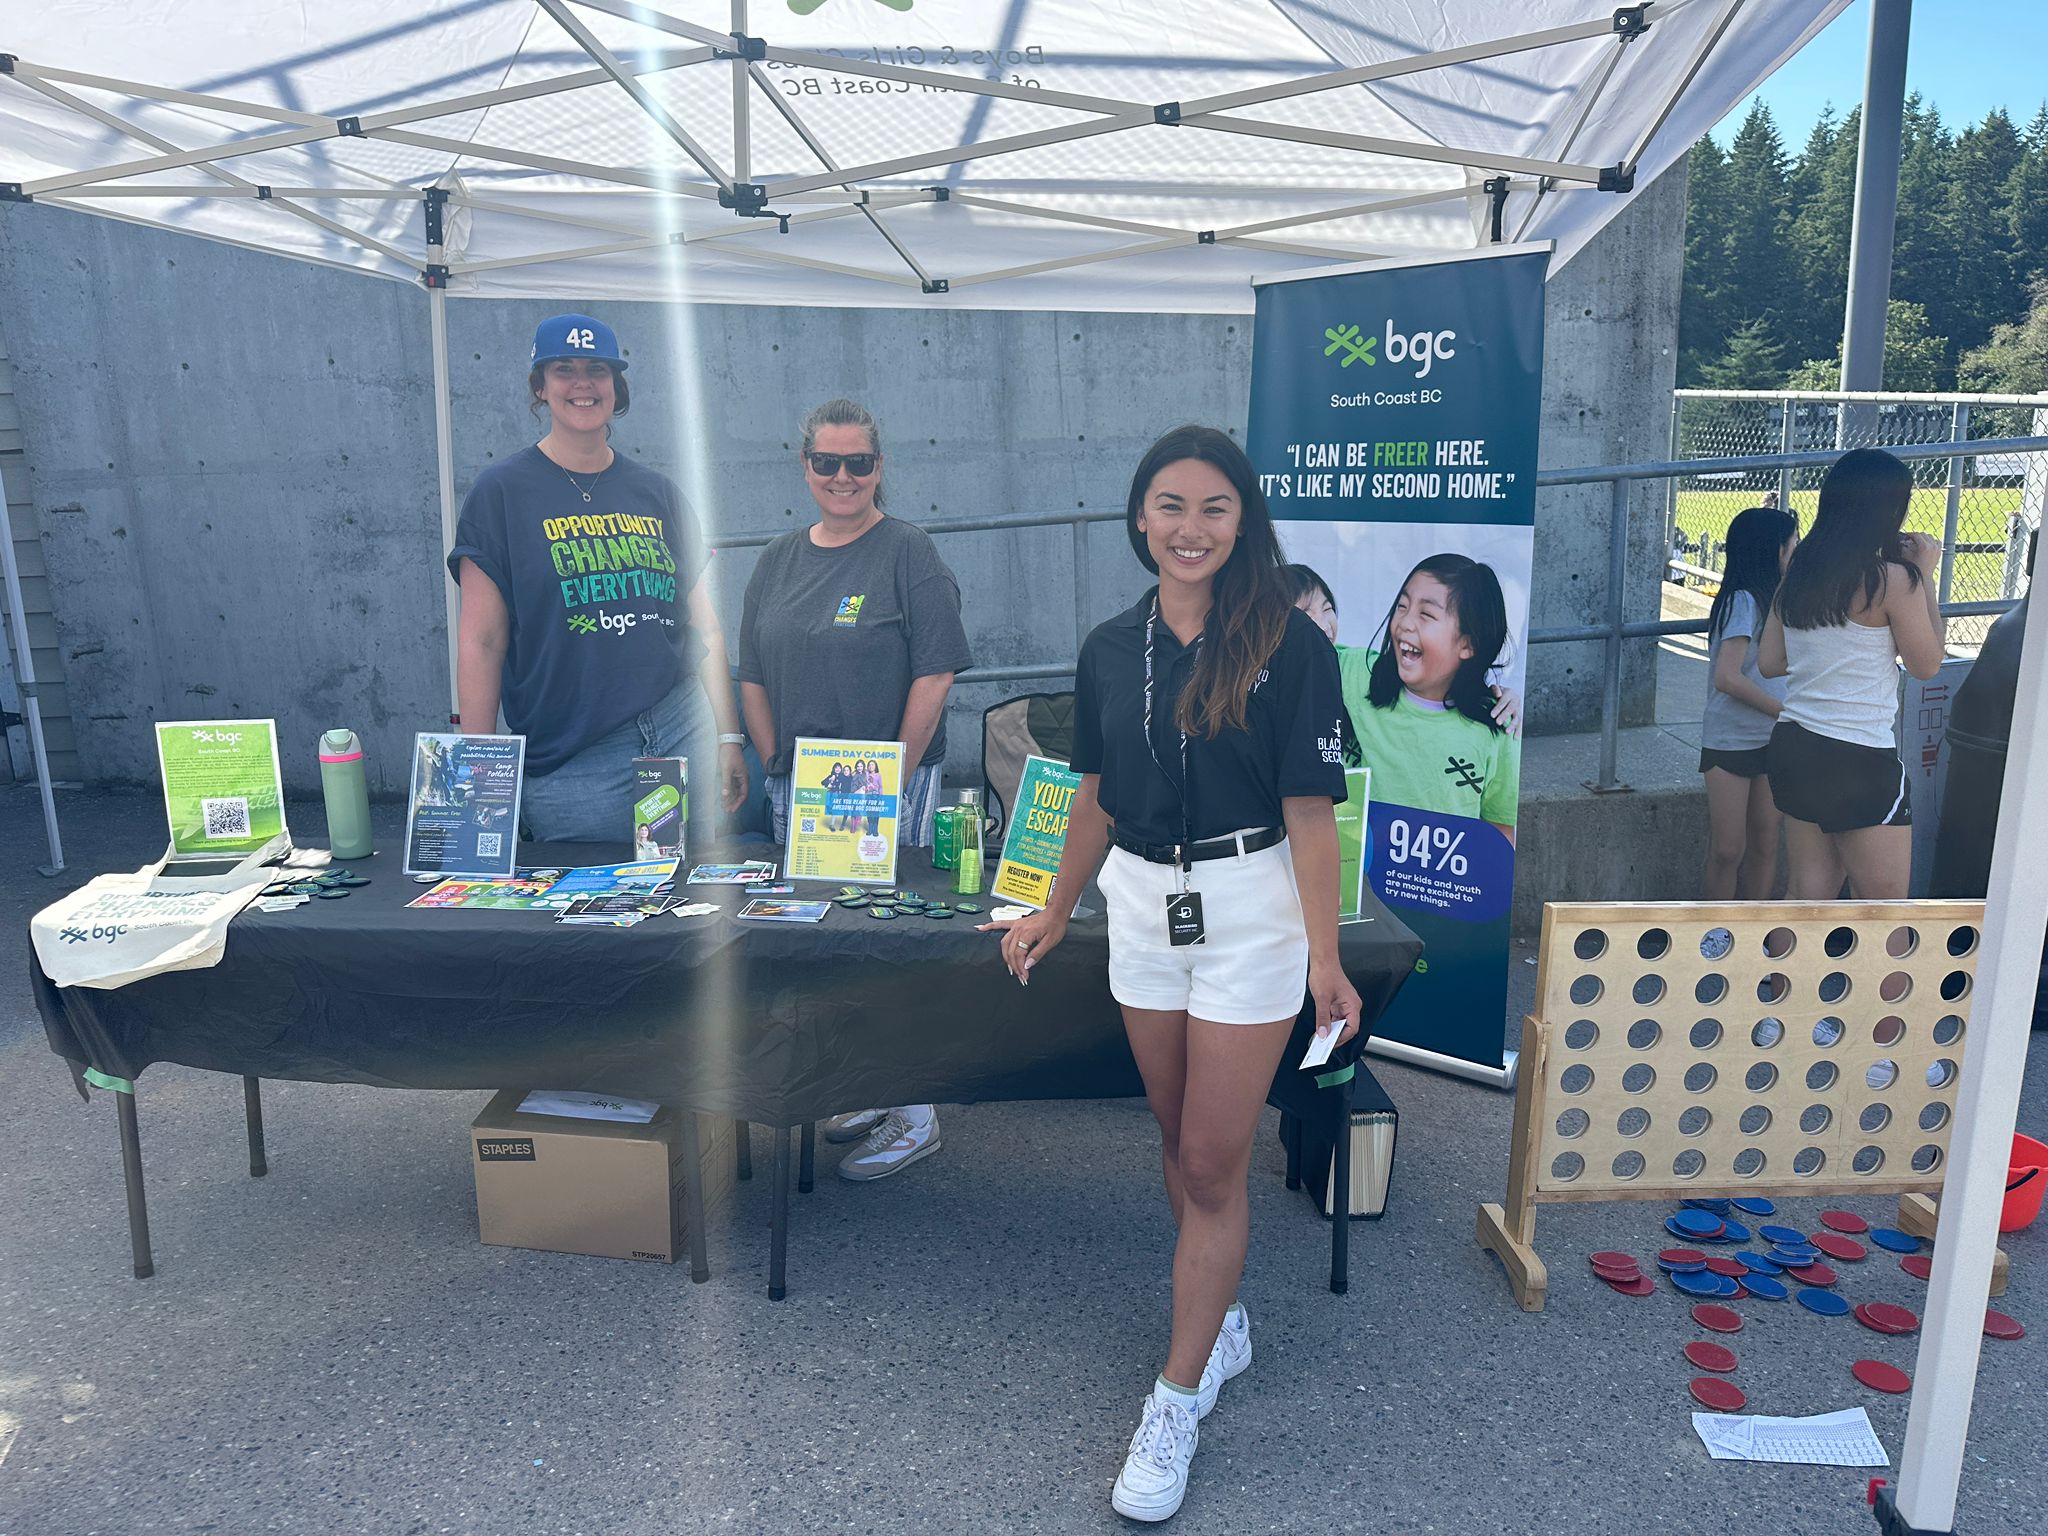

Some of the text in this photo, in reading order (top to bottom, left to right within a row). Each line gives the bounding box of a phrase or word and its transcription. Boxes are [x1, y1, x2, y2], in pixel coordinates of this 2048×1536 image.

[566, 327, 596, 350] 42
[1385, 318, 1456, 379] bgc
[1330, 389, 1442, 407] South Coast BC
[1305, 443, 1340, 468] CAN
[1346, 442, 1367, 467] BE
[1373, 441, 1429, 467] FREER
[1435, 440, 1489, 466] HERE.
[1297, 474, 1333, 498] LIKE
[1339, 474, 1366, 498] MY
[1371, 474, 1440, 499] SECOND
[1447, 473, 1515, 499] HOME.”
[543, 512, 664, 541] OPPORTUNITY
[550, 535, 676, 577] CHANGES
[599, 609, 637, 636] bgc
[216, 729, 243, 746] bgc
[801, 748, 896, 759] SUMMER DAY CAMPS
[495, 763, 512, 771] Camp
[648, 770, 662, 779] bgc
[1052, 768, 1064, 780] bgc
[811, 792, 822, 800] bgc
[1033, 780, 1076, 813] YOUT
[1026, 807, 1069, 837] ESCAP
[1389, 819, 1468, 876] 94%
[1385, 879, 1473, 902] are more excited to
[1386, 869, 1481, 895] of our kids and youth
[1385, 887, 1451, 907] try new things.
[92, 923, 128, 944] bgc
[589, 1100, 608, 1110] bgc
[481, 1143, 531, 1155] STAPLES
